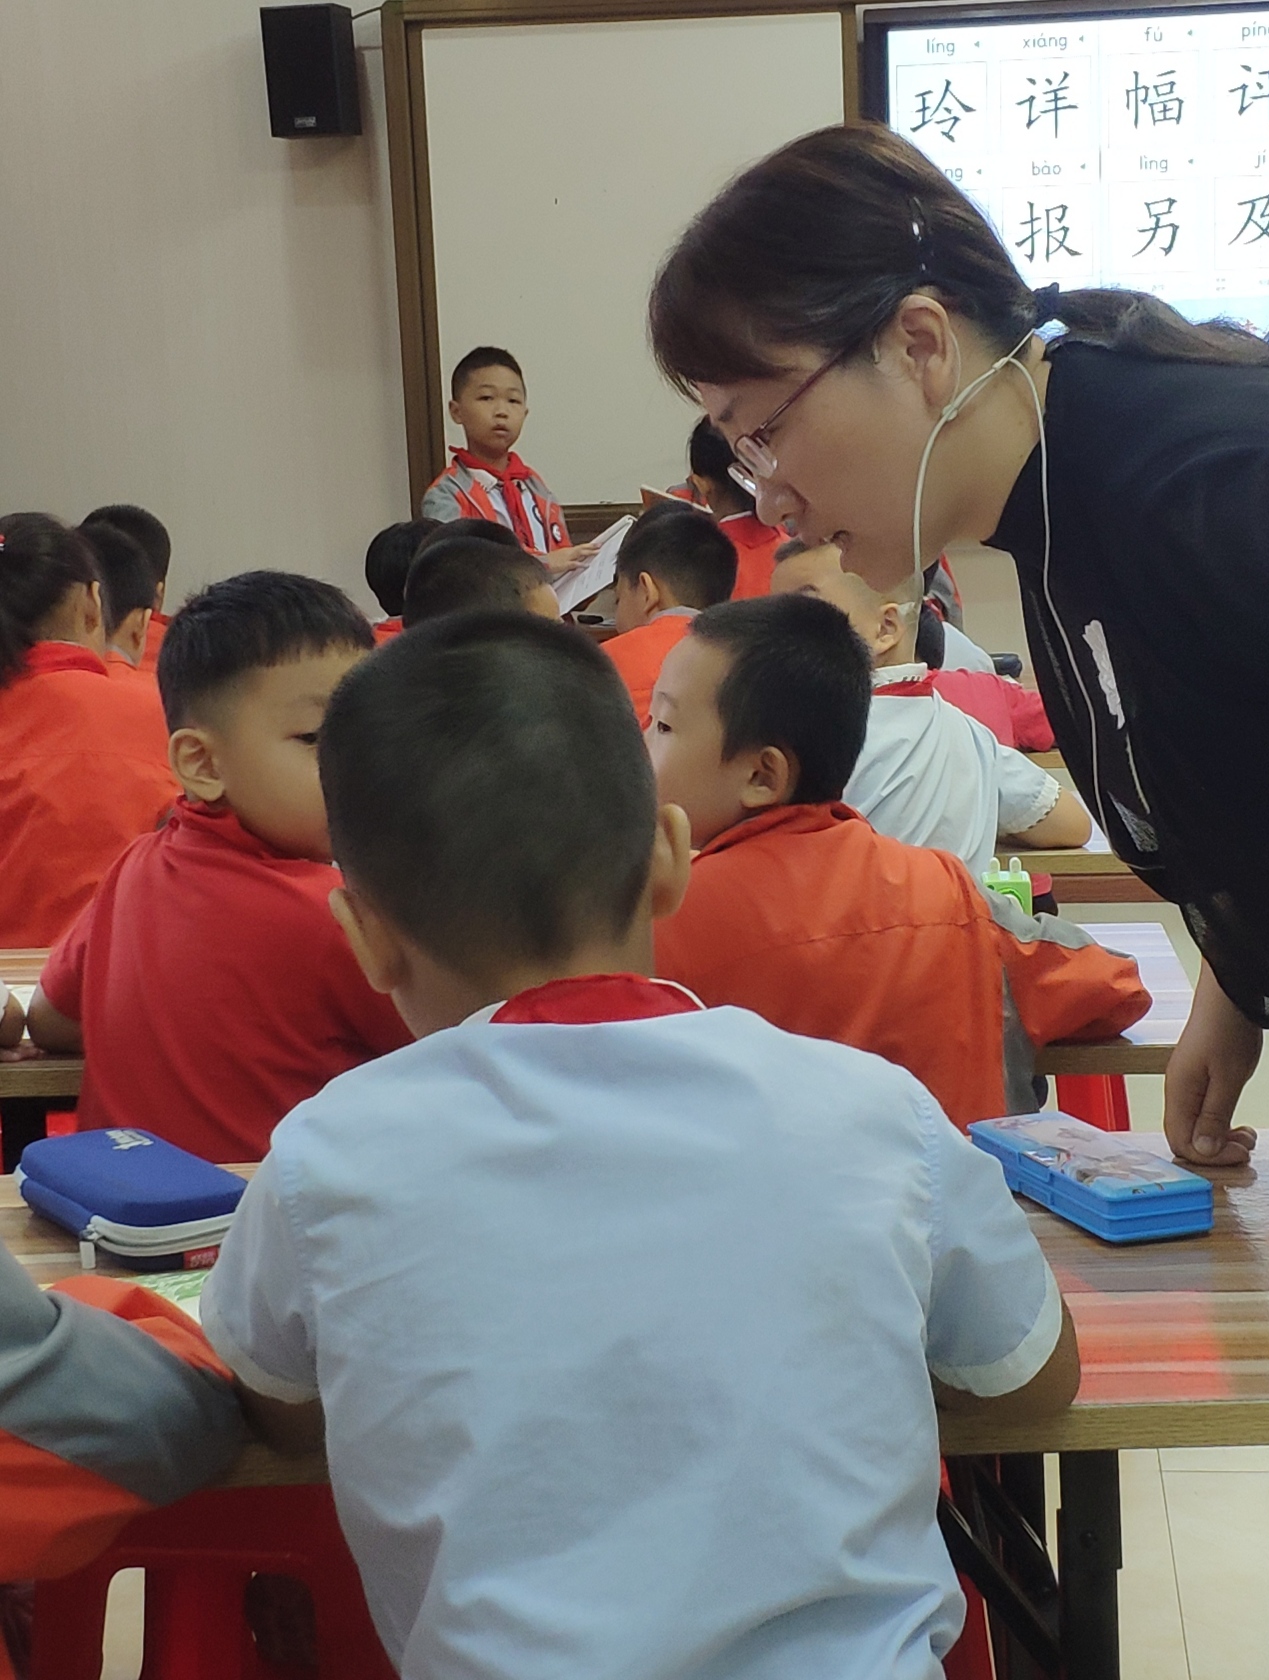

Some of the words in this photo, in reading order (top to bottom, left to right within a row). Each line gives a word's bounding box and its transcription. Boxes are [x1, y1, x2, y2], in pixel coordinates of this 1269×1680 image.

[1021, 32, 1069, 51] xiáng
[910, 79, 976, 142] 玲
[1016, 71, 1079, 138] 详
[1125, 70, 1184, 129] 幅
[1015, 201, 1083, 263] 报
[1132, 197, 1180, 257] 另
